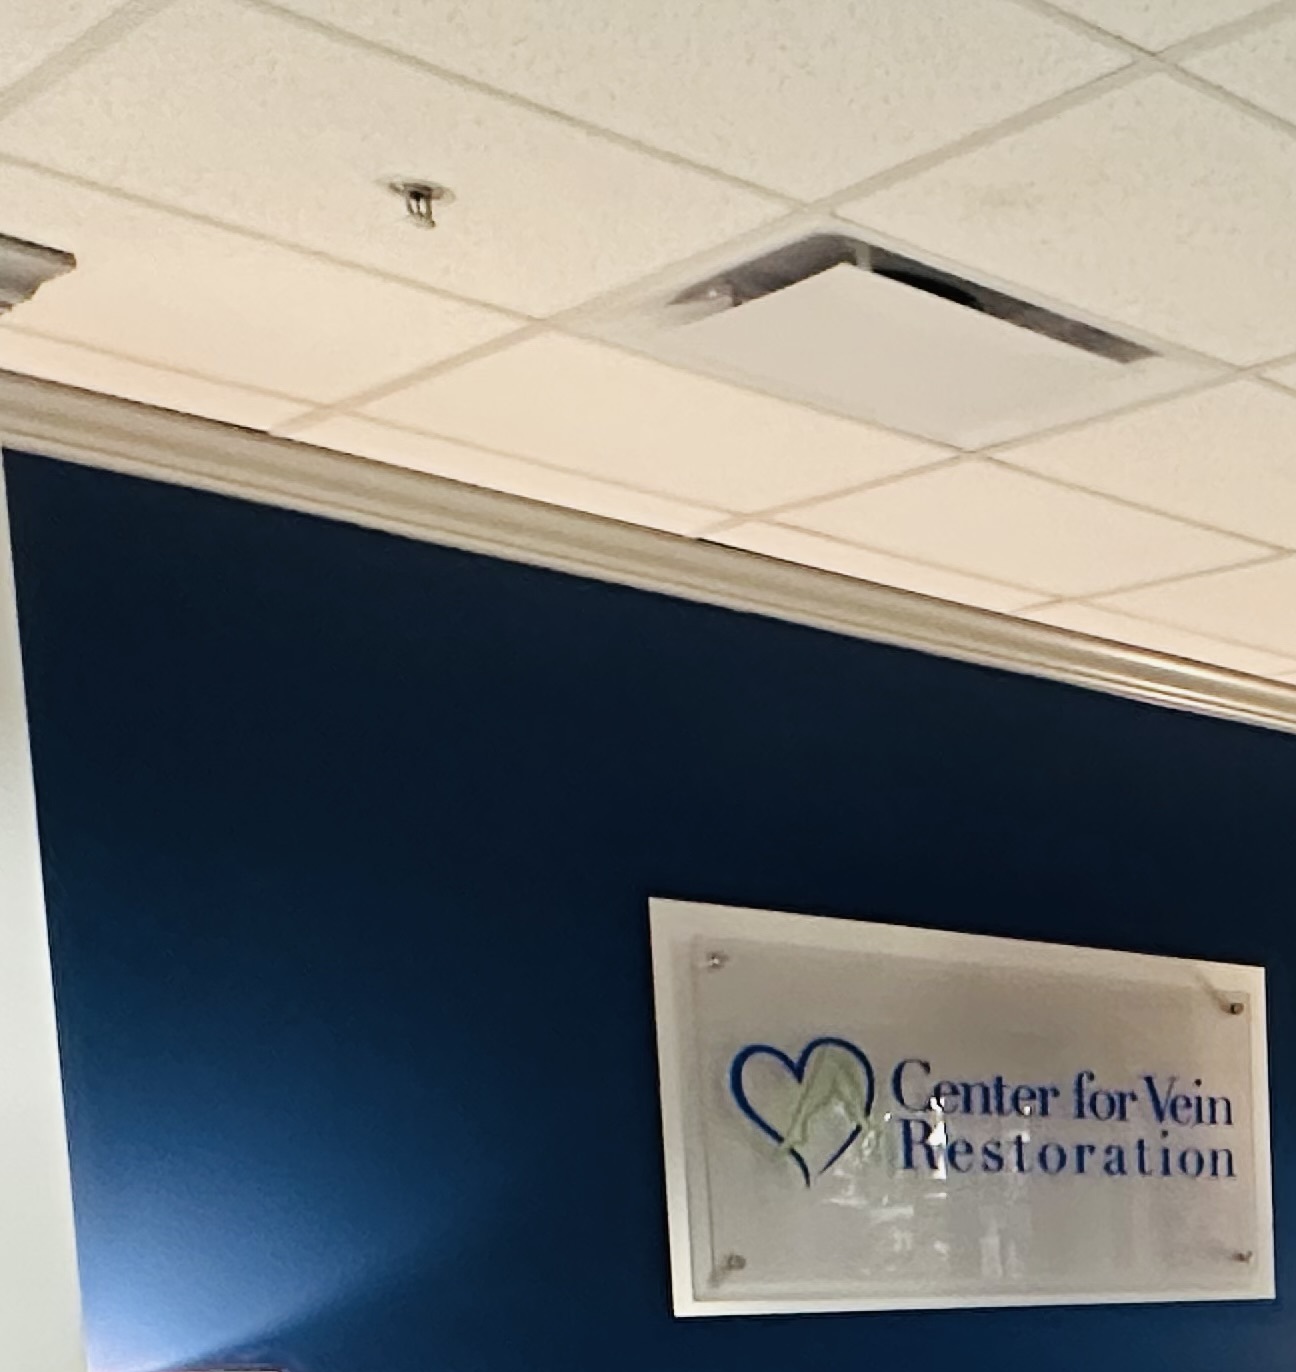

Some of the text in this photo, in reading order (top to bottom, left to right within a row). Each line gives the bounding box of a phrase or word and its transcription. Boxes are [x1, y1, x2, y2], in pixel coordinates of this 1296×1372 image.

[891, 1058, 1234, 1127] Center for Vein
[898, 1117, 1236, 1179] Restoration
